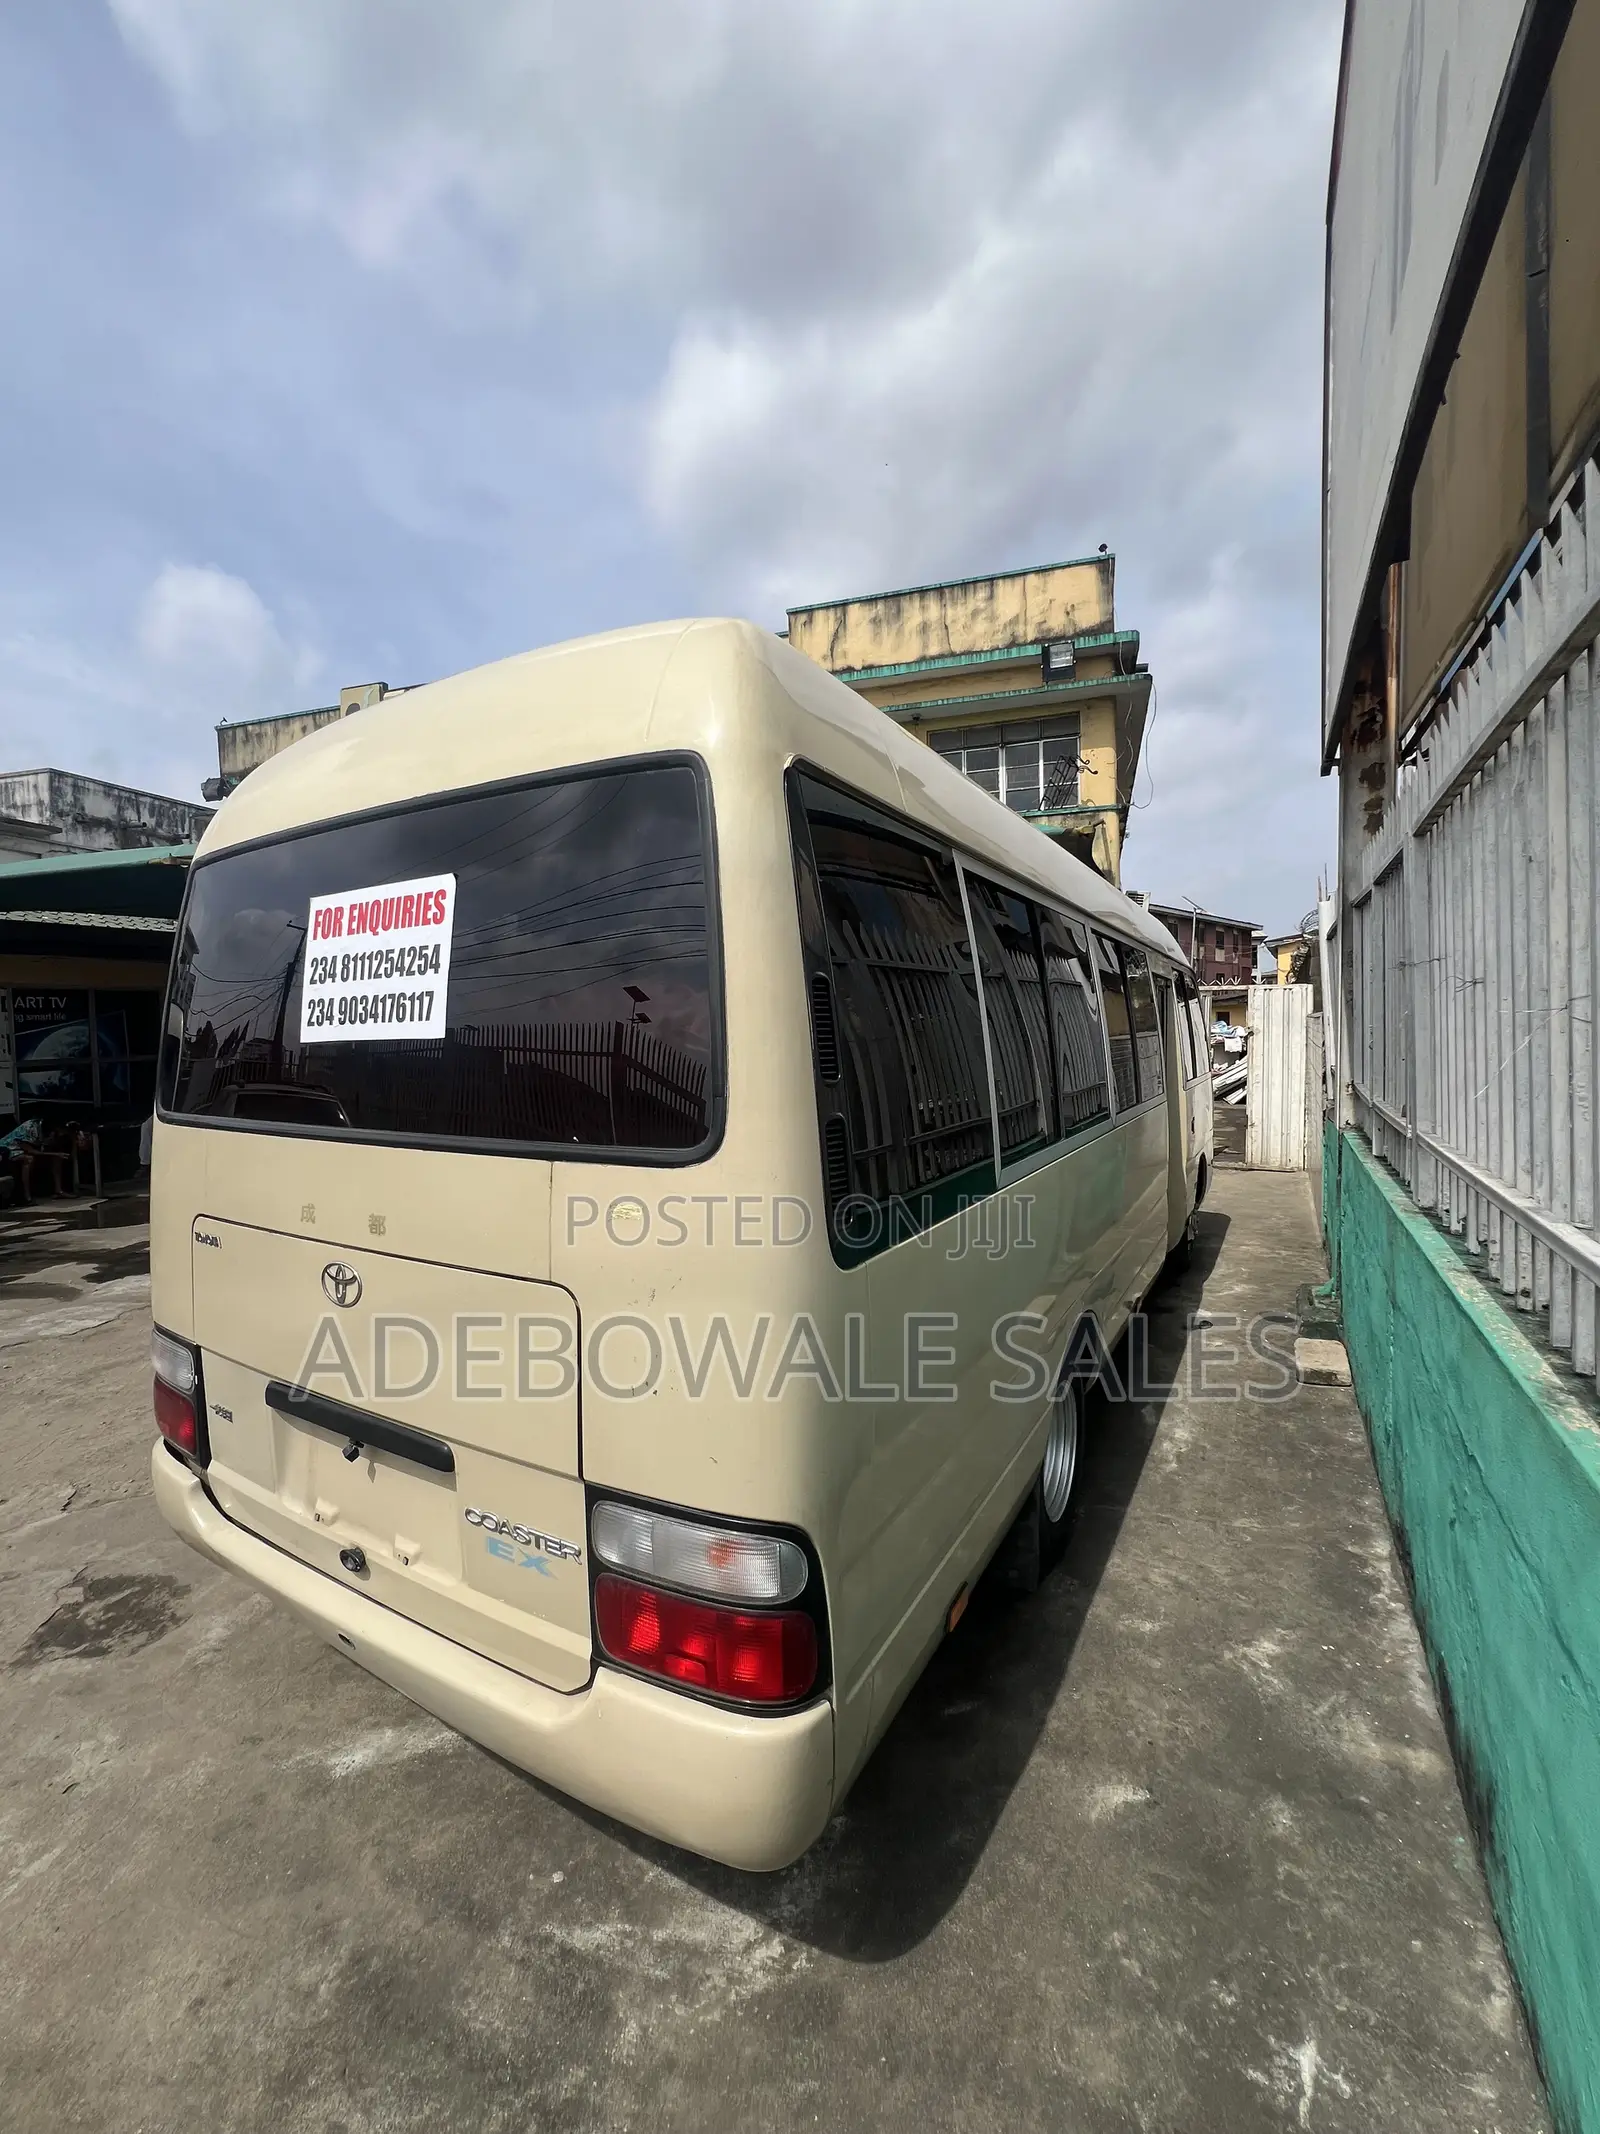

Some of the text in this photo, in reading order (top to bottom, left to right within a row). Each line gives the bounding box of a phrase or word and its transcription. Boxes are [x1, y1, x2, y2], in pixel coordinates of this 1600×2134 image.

[313, 889, 447, 940] FOR ENQUIRIES
[310, 944, 441, 985] 234 8111254254
[49, 996, 67, 1009] TV
[307, 990, 434, 1027] 234 9034176117
[464, 1507, 583, 1566] COASTER
[487, 1536, 559, 1580] EX
